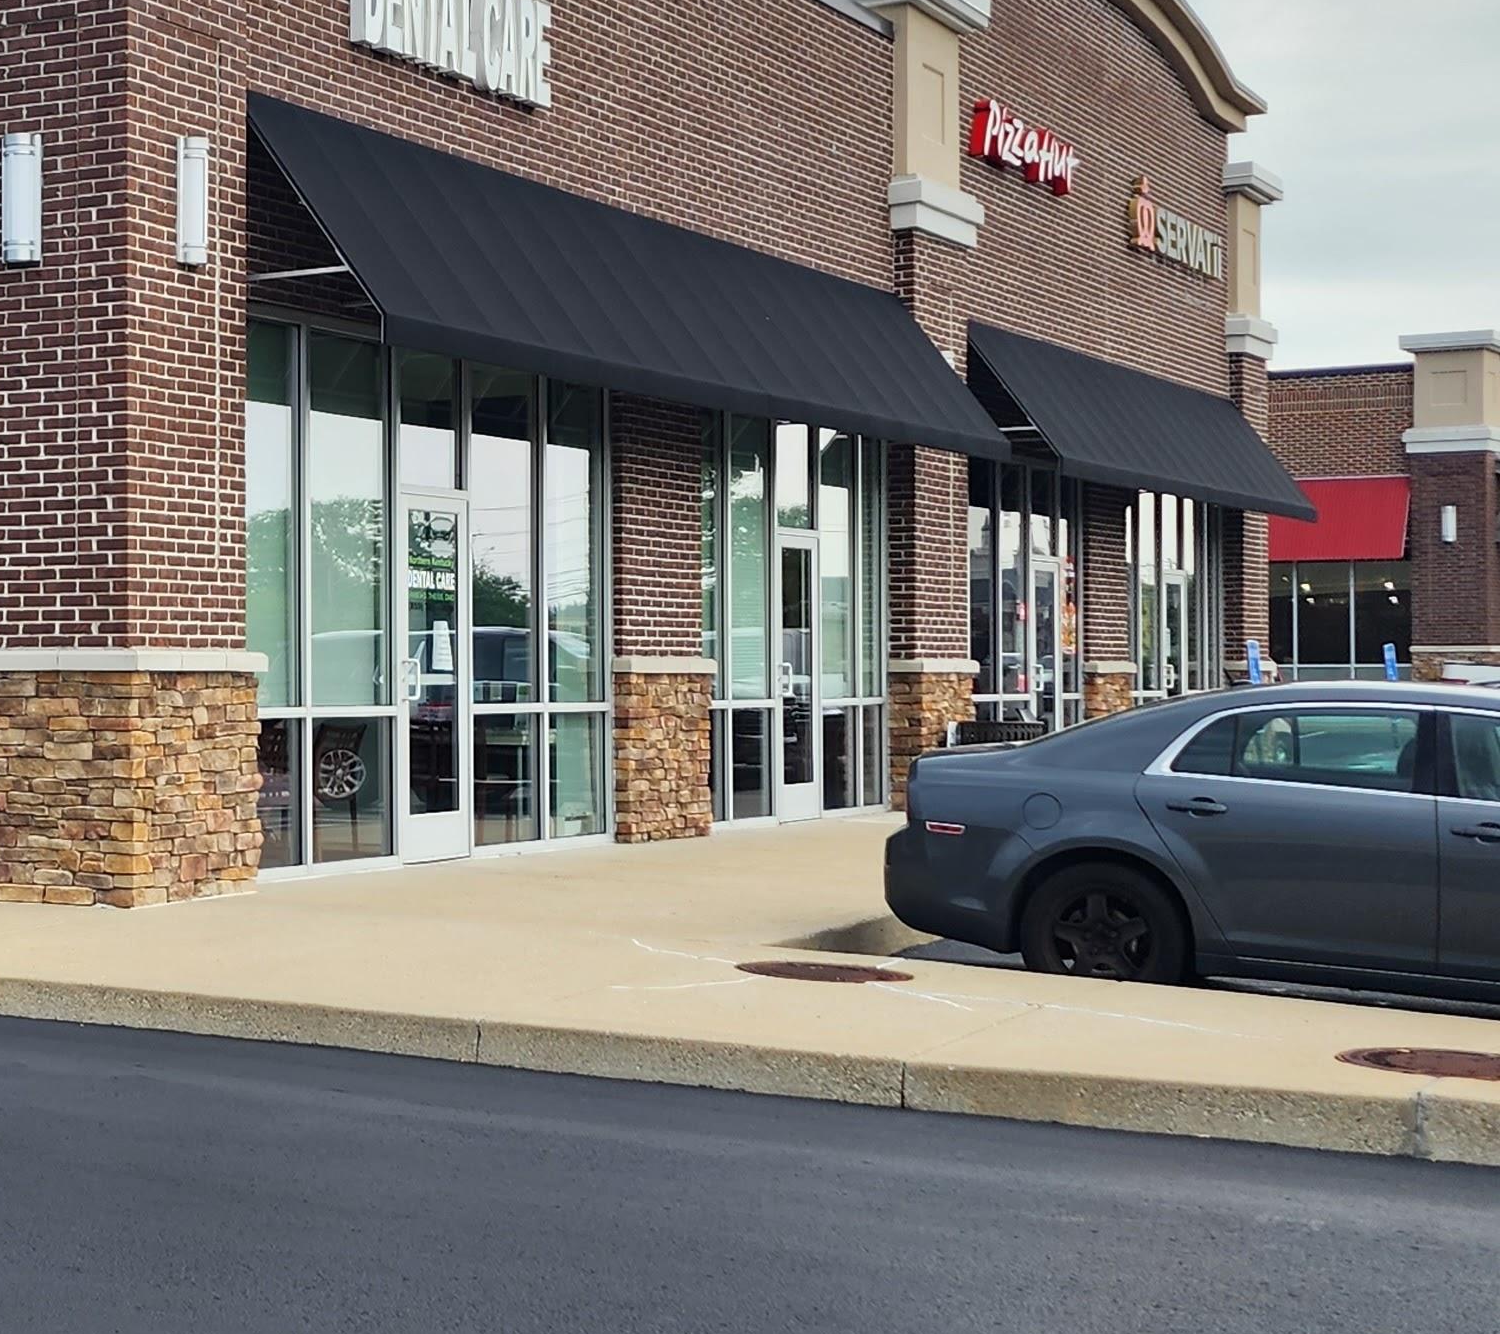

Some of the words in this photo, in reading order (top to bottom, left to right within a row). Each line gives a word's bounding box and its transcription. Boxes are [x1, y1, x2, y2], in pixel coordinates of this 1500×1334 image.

[981, 99, 1040, 167] Pizza
[1039, 129, 1081, 193] Hut
[408, 569, 435, 589] DENTAL
[435, 571, 455, 591] CARE
